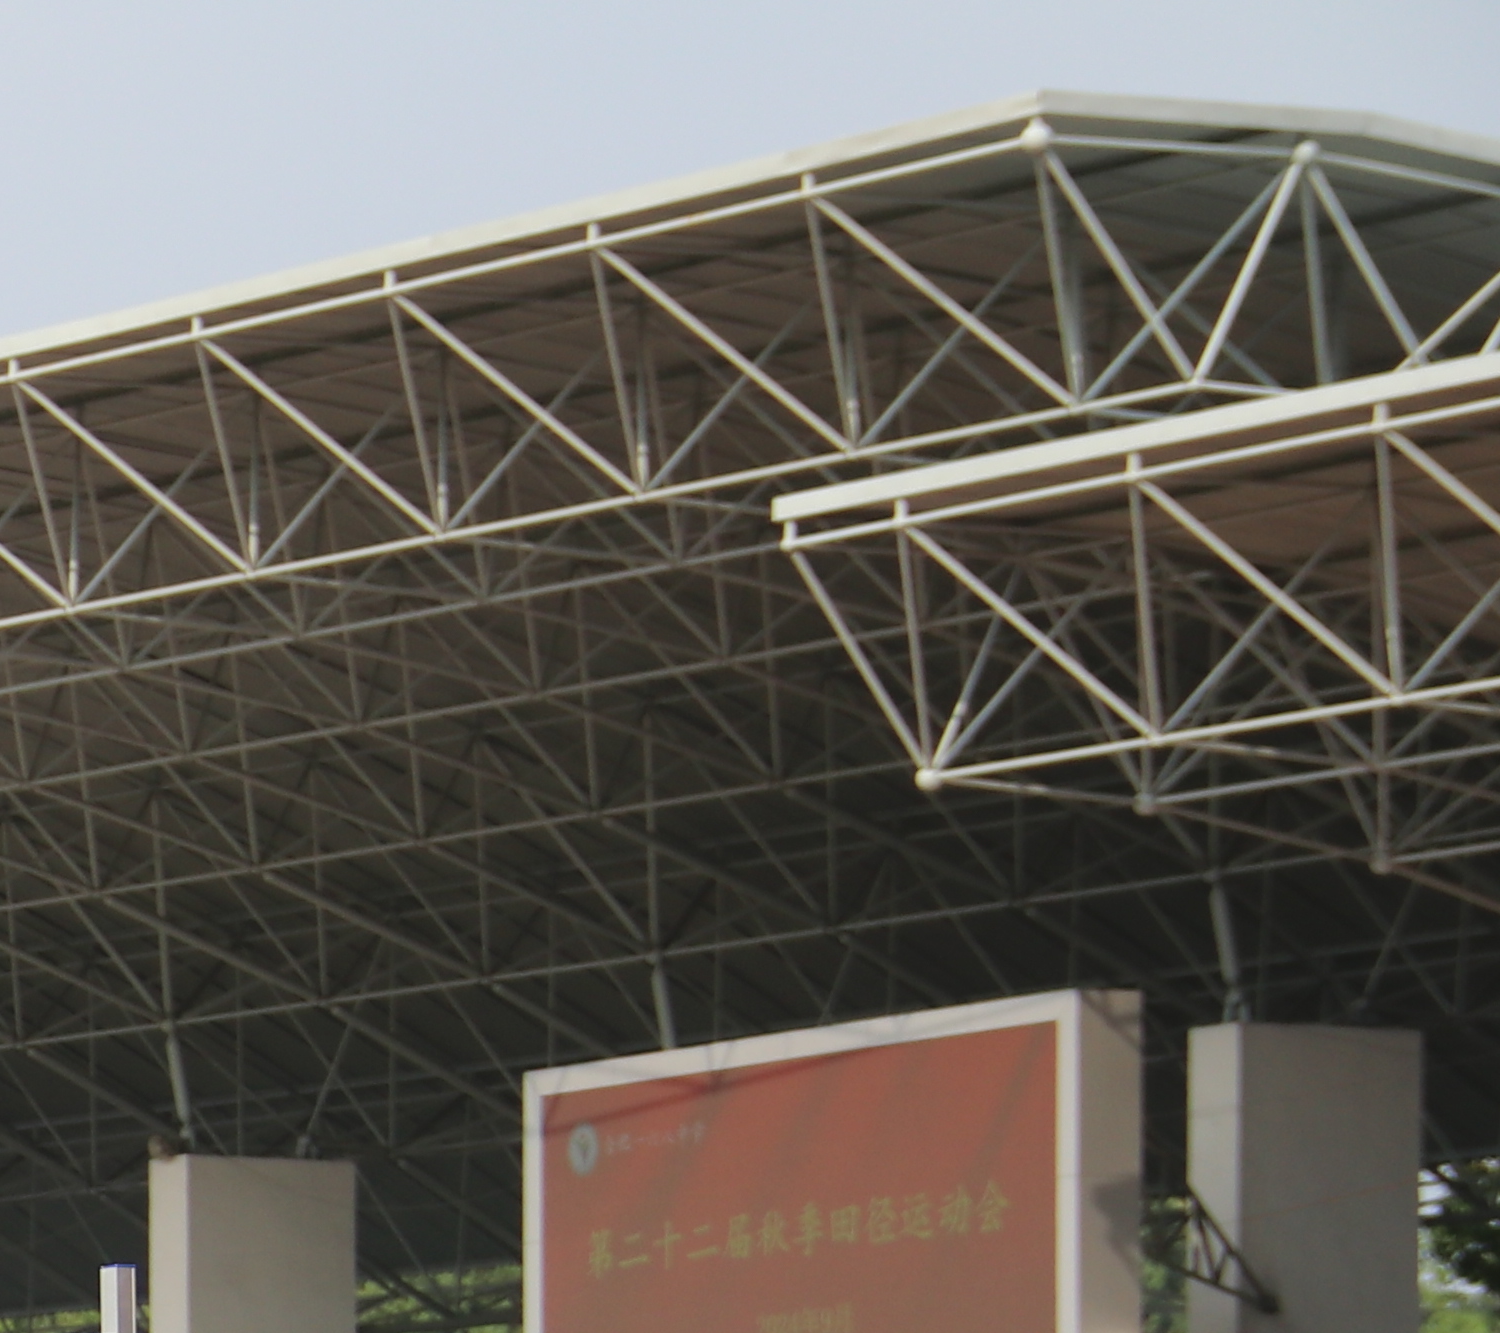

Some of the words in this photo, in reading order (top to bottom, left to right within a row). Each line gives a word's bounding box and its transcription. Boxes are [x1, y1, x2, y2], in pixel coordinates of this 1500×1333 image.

[587, 1180, 1010, 1279] 第二十二届秋季田径运动会
